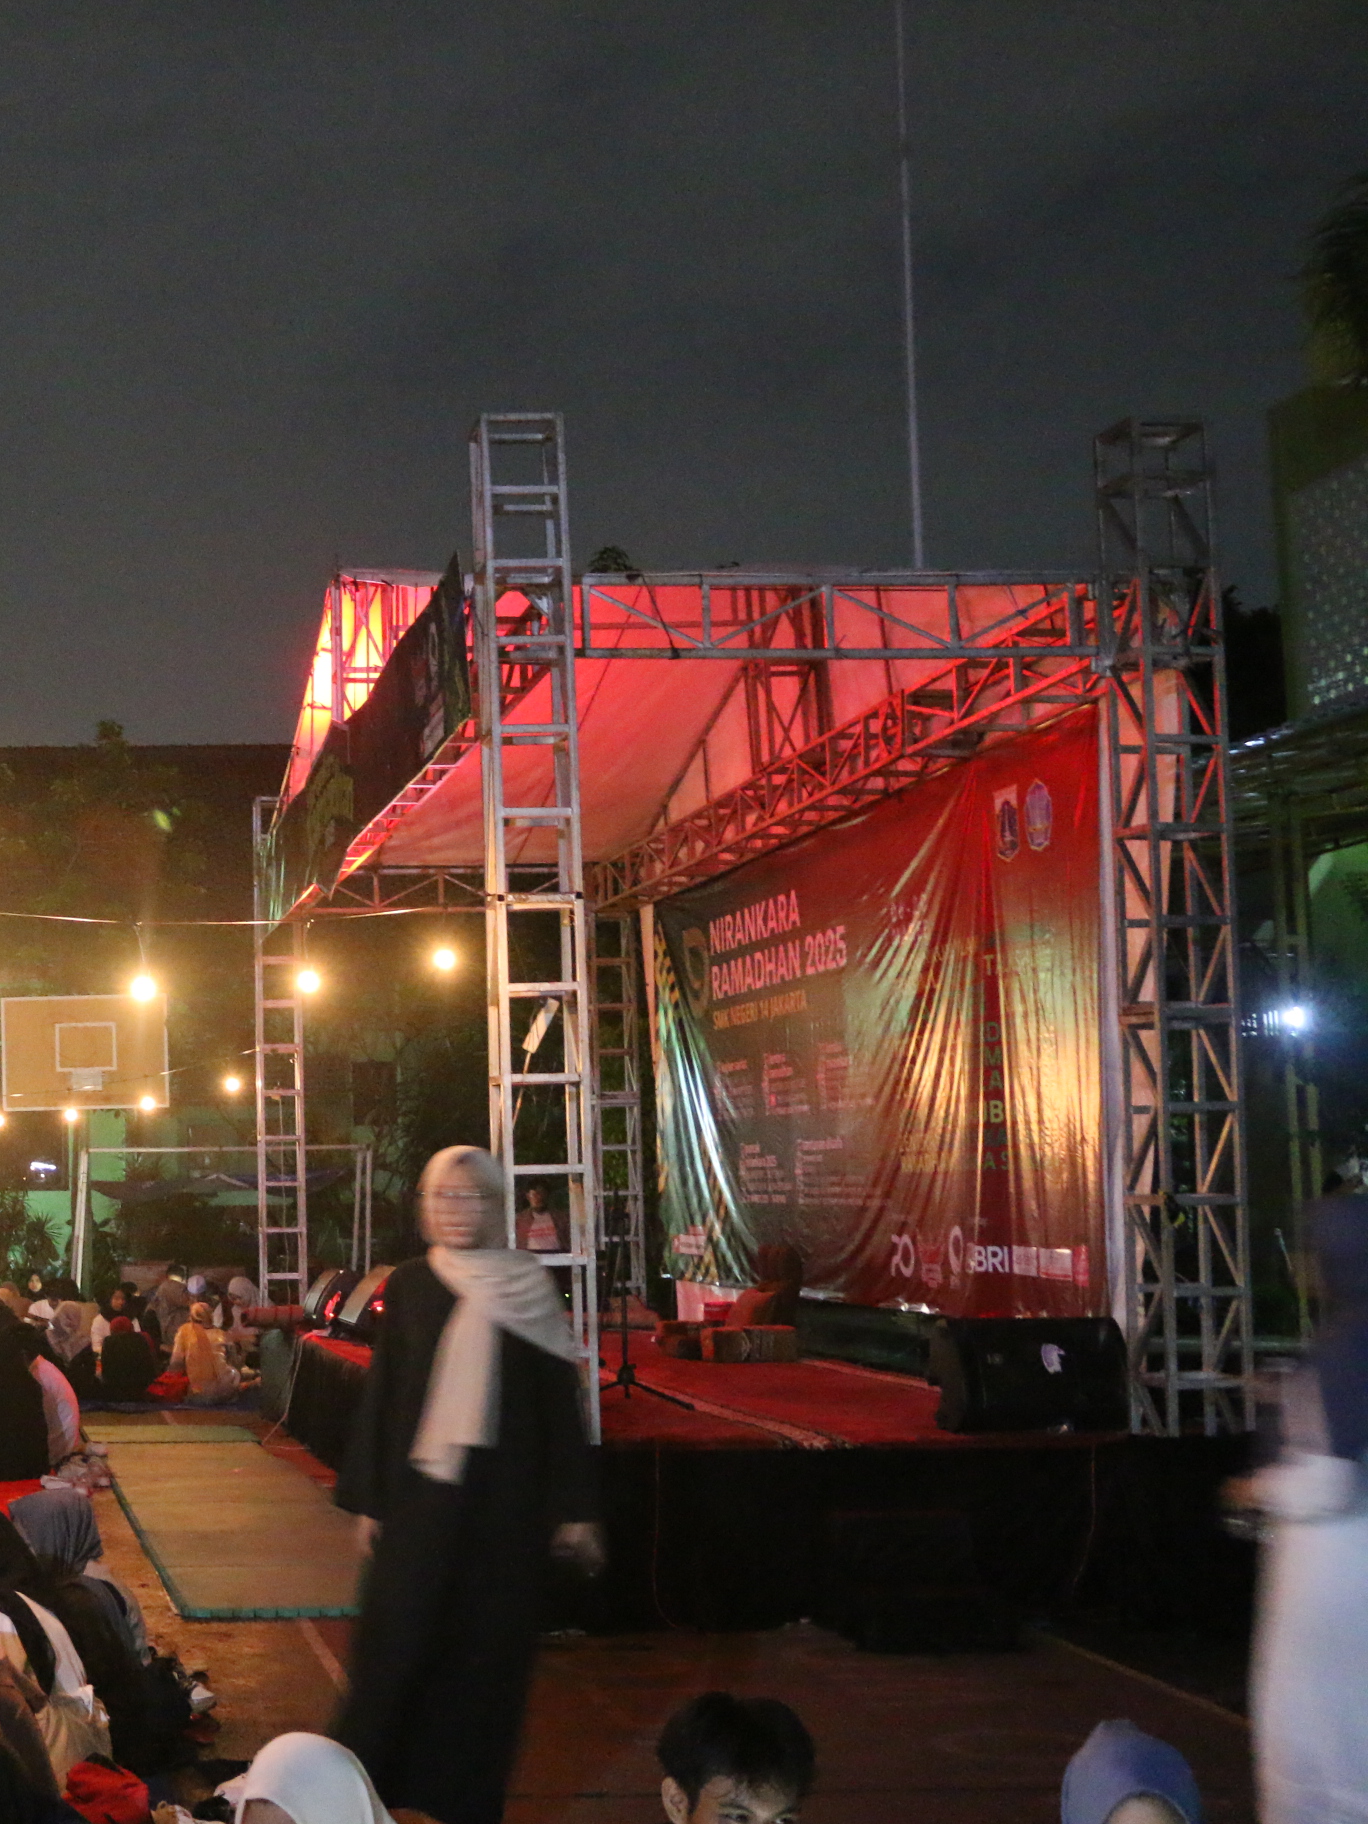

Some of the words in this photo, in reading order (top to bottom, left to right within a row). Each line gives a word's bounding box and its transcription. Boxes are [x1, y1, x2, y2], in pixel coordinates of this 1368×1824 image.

[709, 889, 801, 956] NIRANKARA
[711, 939, 801, 1000] RAMADHAN
[804, 924, 847, 975] 2025
[974, 1245, 1010, 1273] BRI
